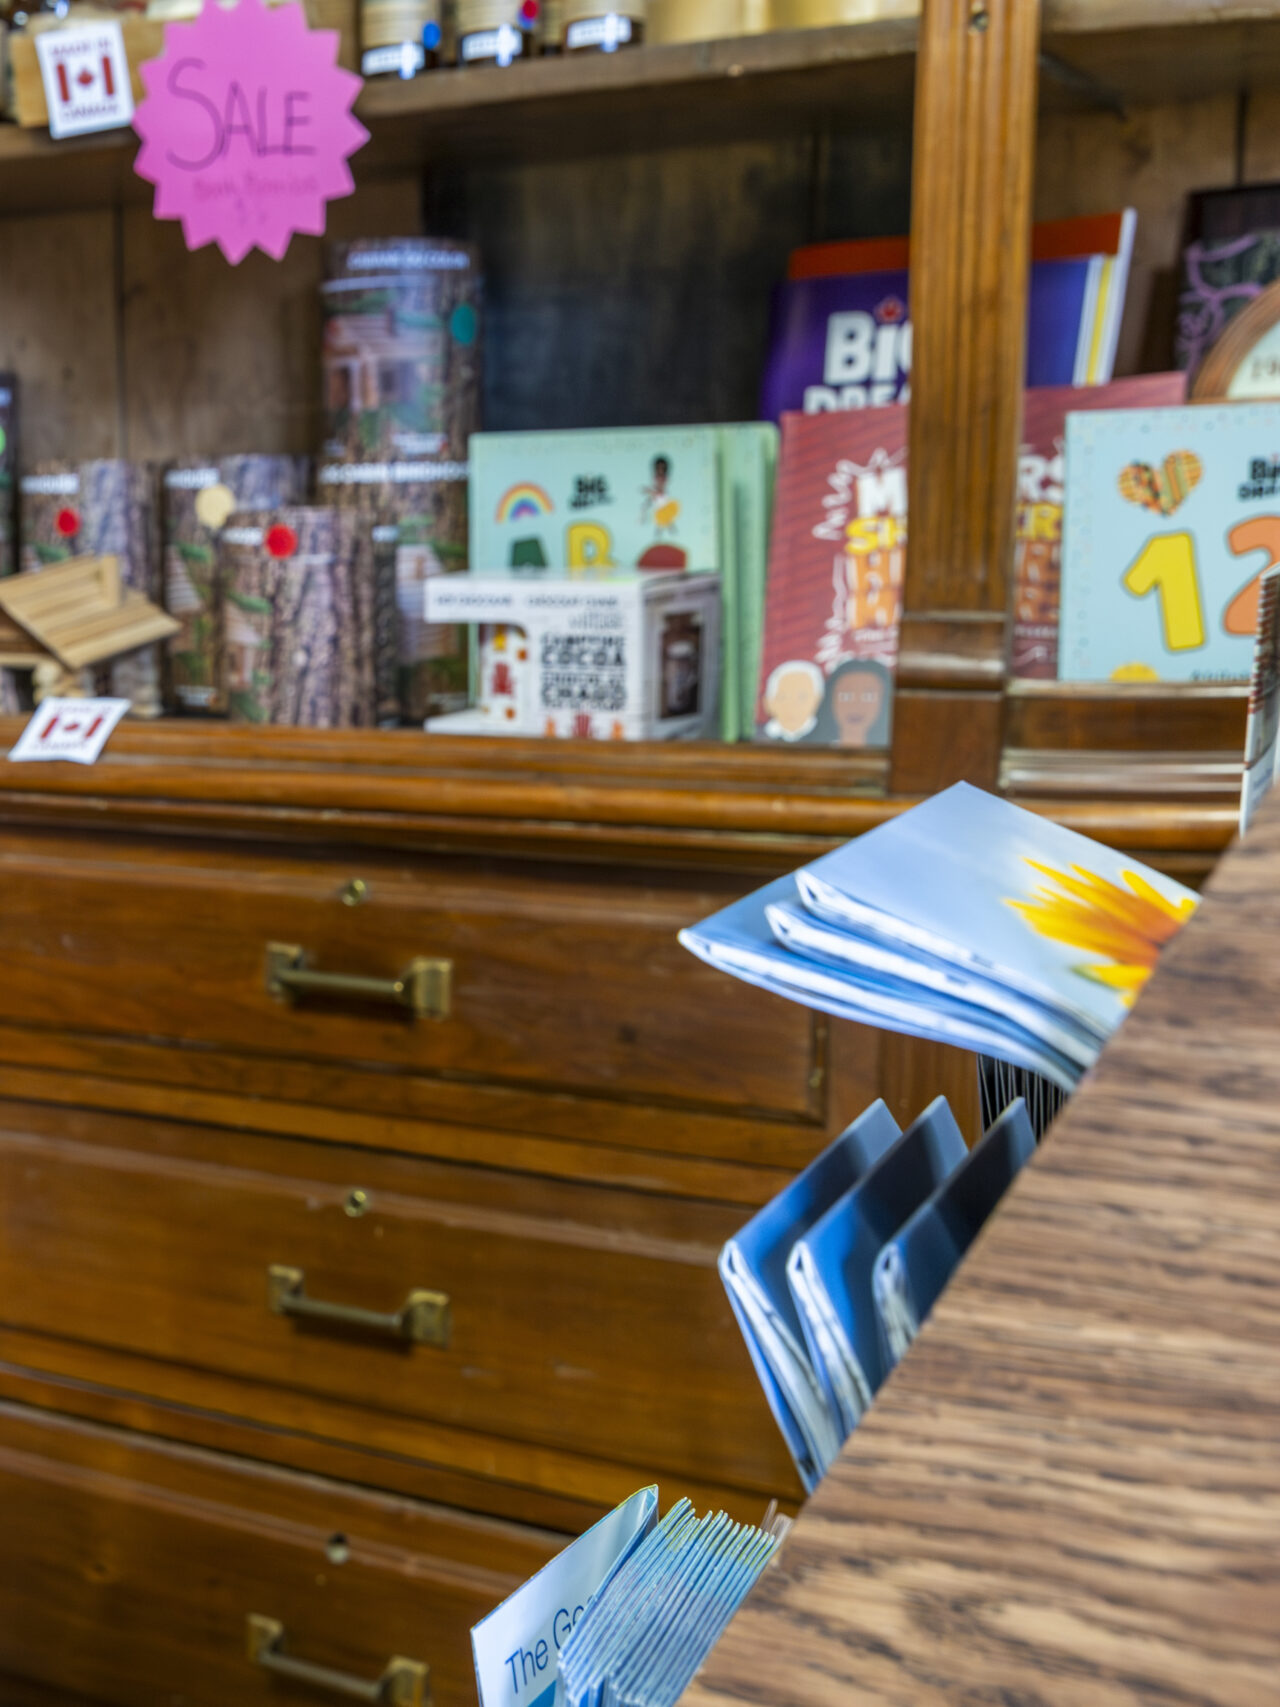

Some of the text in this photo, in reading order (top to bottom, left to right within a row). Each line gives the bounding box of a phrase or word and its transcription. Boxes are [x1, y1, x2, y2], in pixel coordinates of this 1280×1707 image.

[165, 57, 317, 172] SALE
[1124, 531, 1205, 653] 1
[504, 1639, 549, 1695] The
